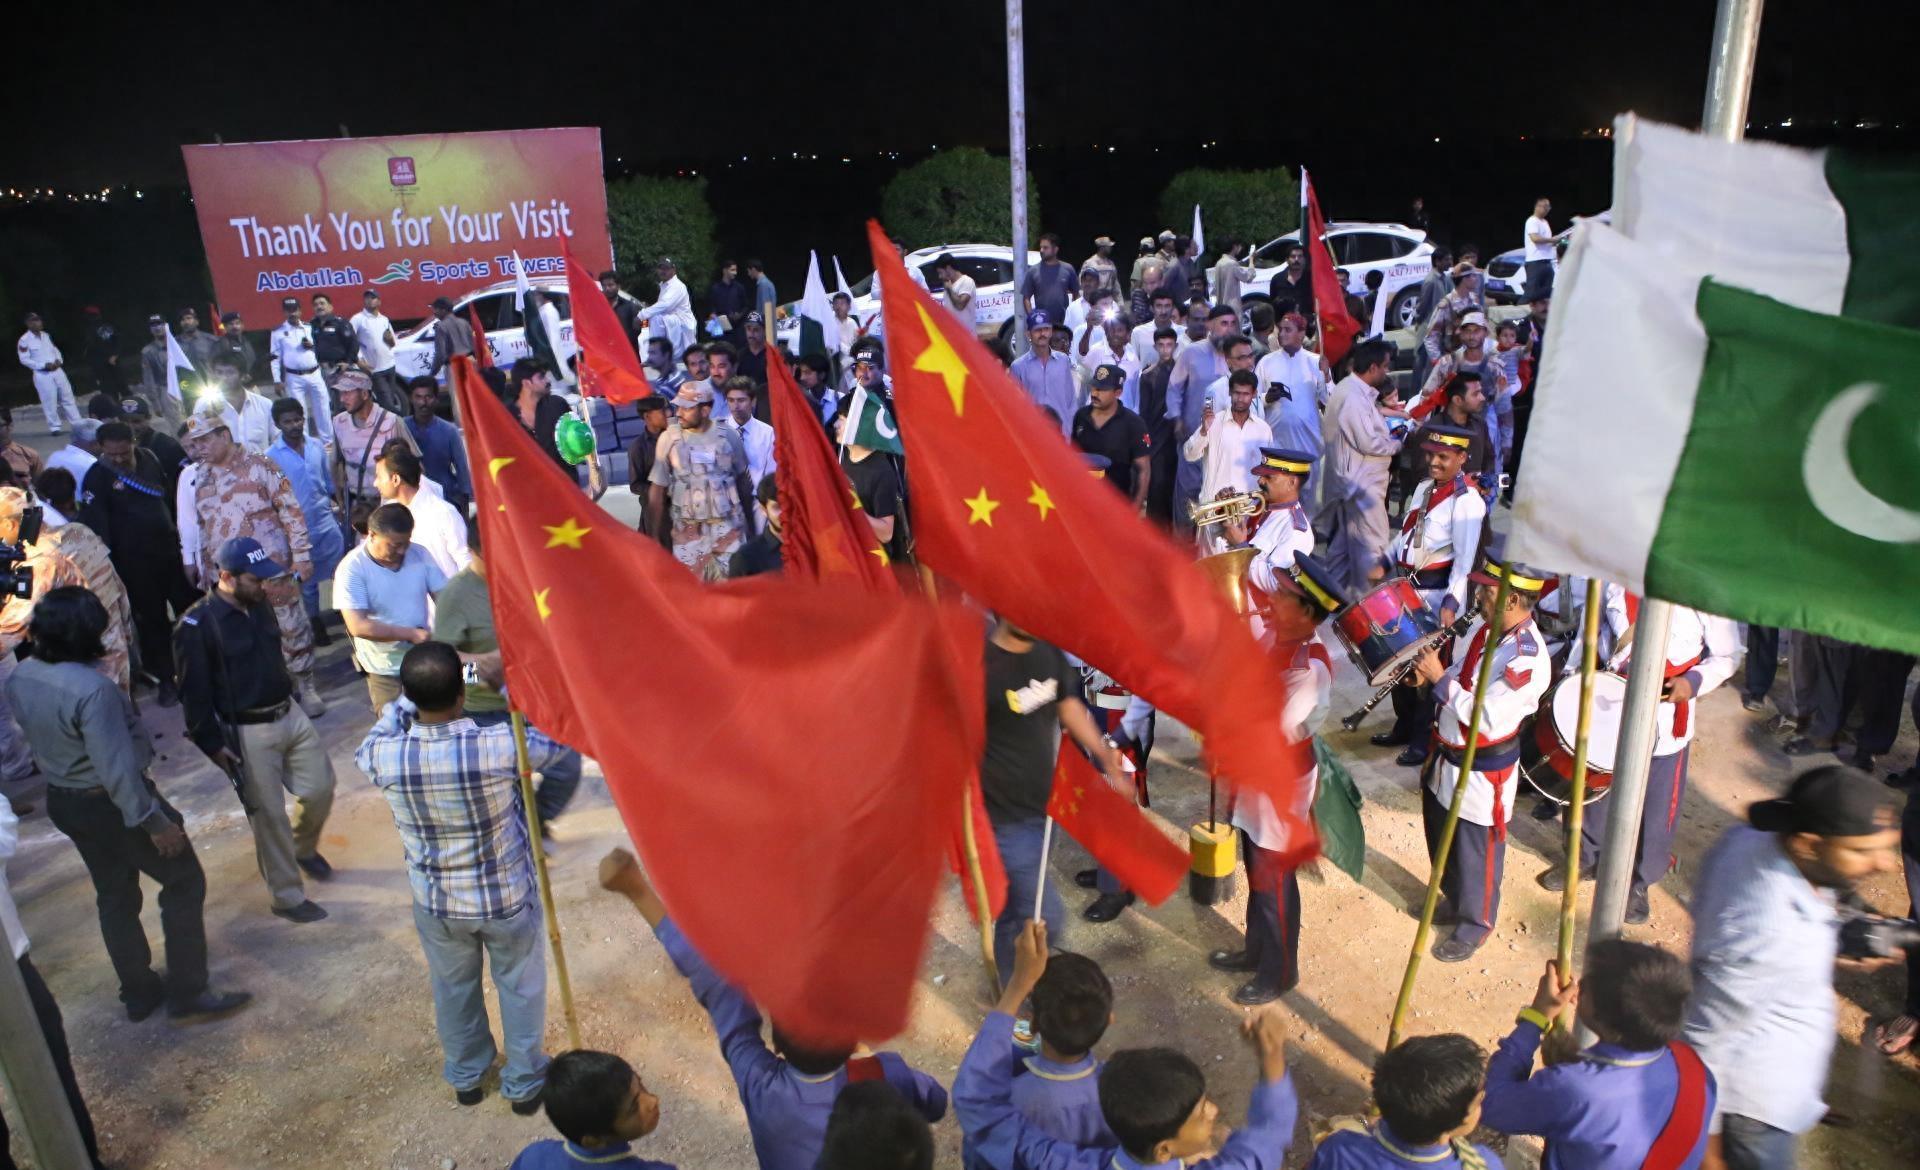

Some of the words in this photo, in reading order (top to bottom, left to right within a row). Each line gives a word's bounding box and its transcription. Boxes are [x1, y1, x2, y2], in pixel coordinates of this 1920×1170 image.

[229, 213, 327, 257] Thank
[329, 212, 385, 251] You
[391, 207, 432, 247] for
[439, 204, 503, 244] Your
[510, 199, 573, 240] Visit
[256, 266, 363, 292] Abdullah
[419, 258, 490, 284] Sports
[496, 255, 565, 276] Towers
